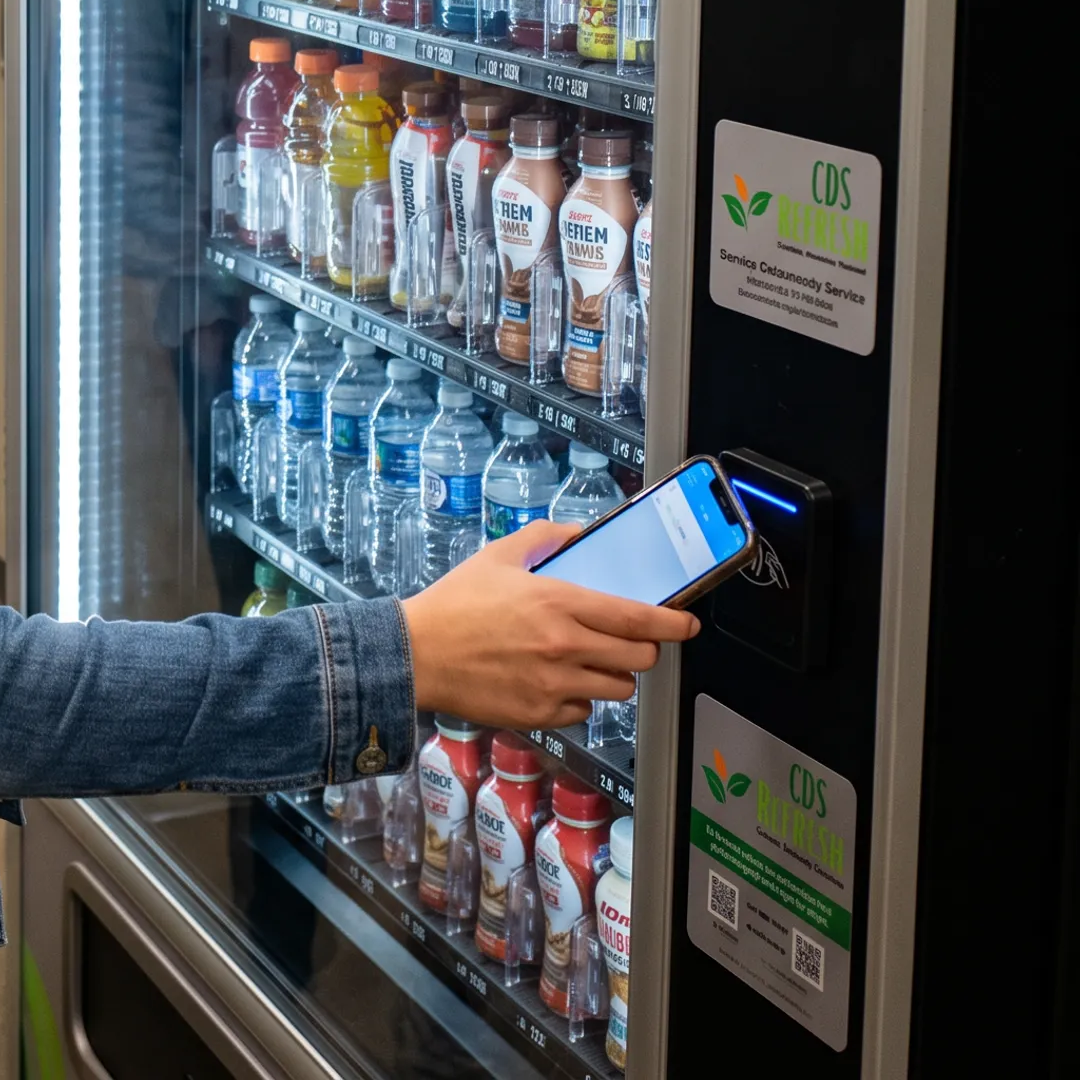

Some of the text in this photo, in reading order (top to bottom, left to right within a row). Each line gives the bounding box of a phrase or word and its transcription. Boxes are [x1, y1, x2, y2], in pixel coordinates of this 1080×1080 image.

[811, 160, 852, 211] CDS
[777, 192, 869, 263] REFRESH
[789, 762, 828, 819] CDS
